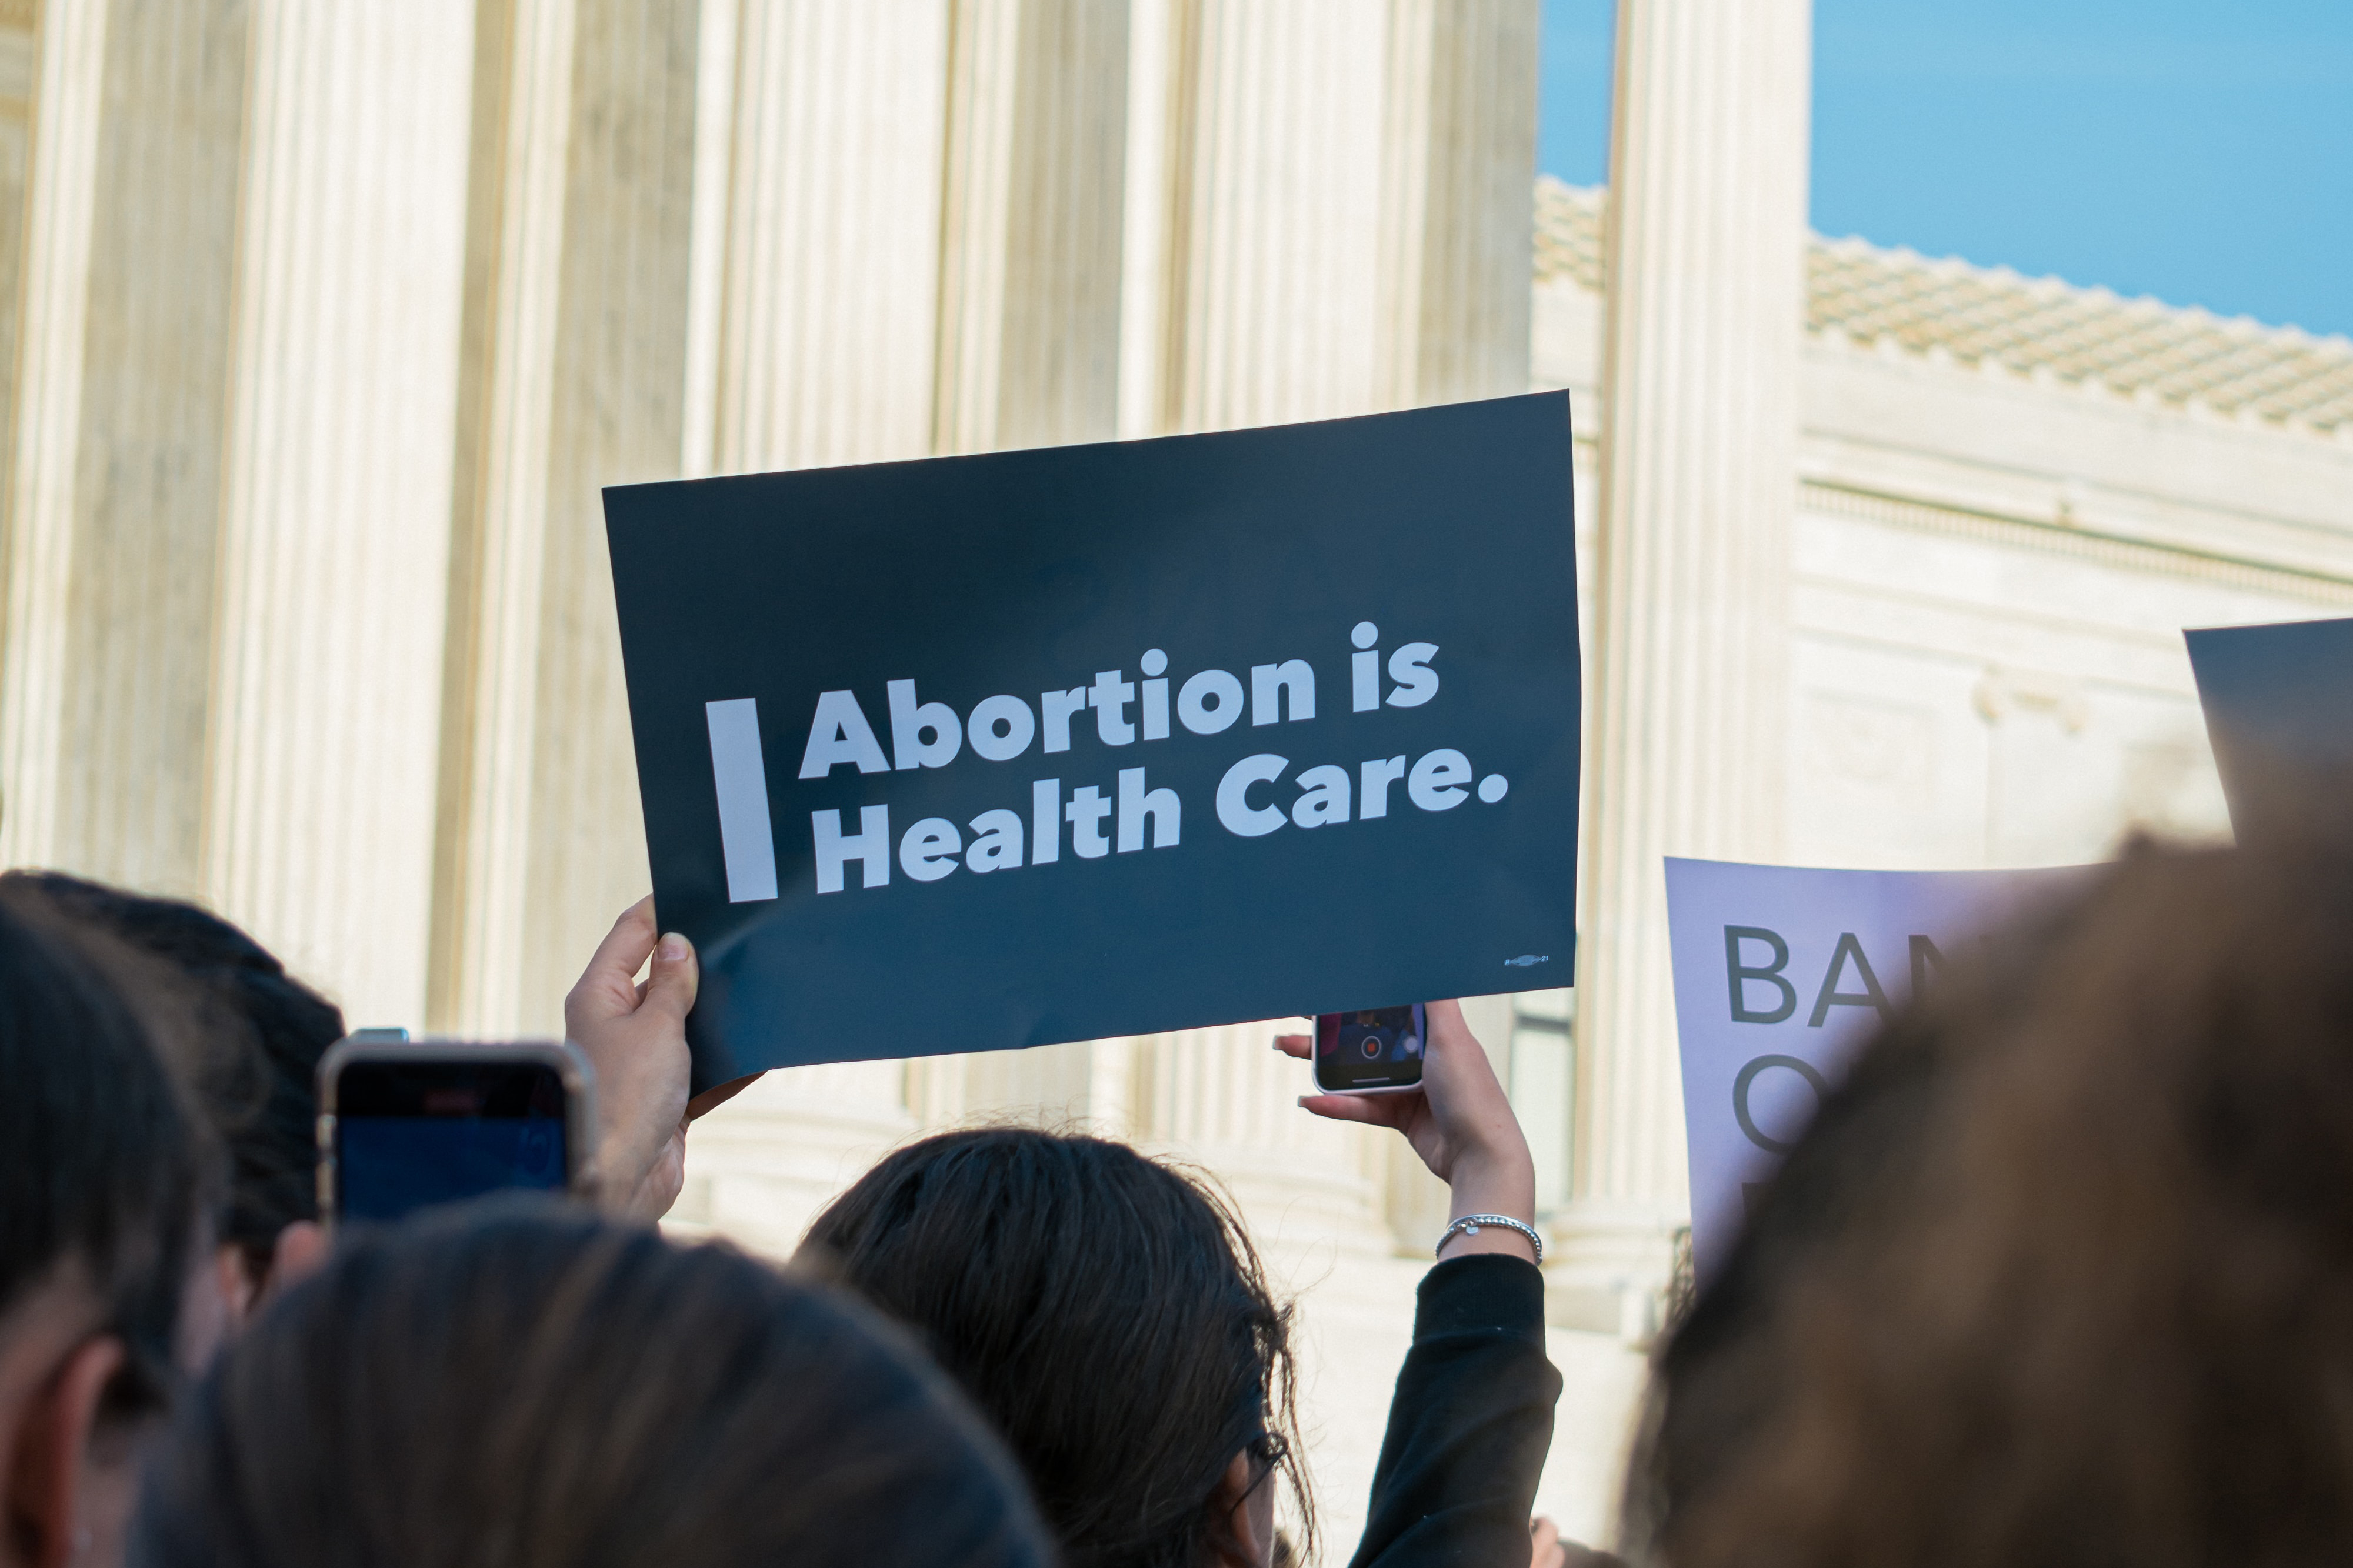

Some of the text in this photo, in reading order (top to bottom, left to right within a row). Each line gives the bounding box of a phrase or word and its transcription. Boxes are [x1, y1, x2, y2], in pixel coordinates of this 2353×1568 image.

[799, 621, 1439, 779] Abortion is
[812, 749, 1508, 894] Health Care.
